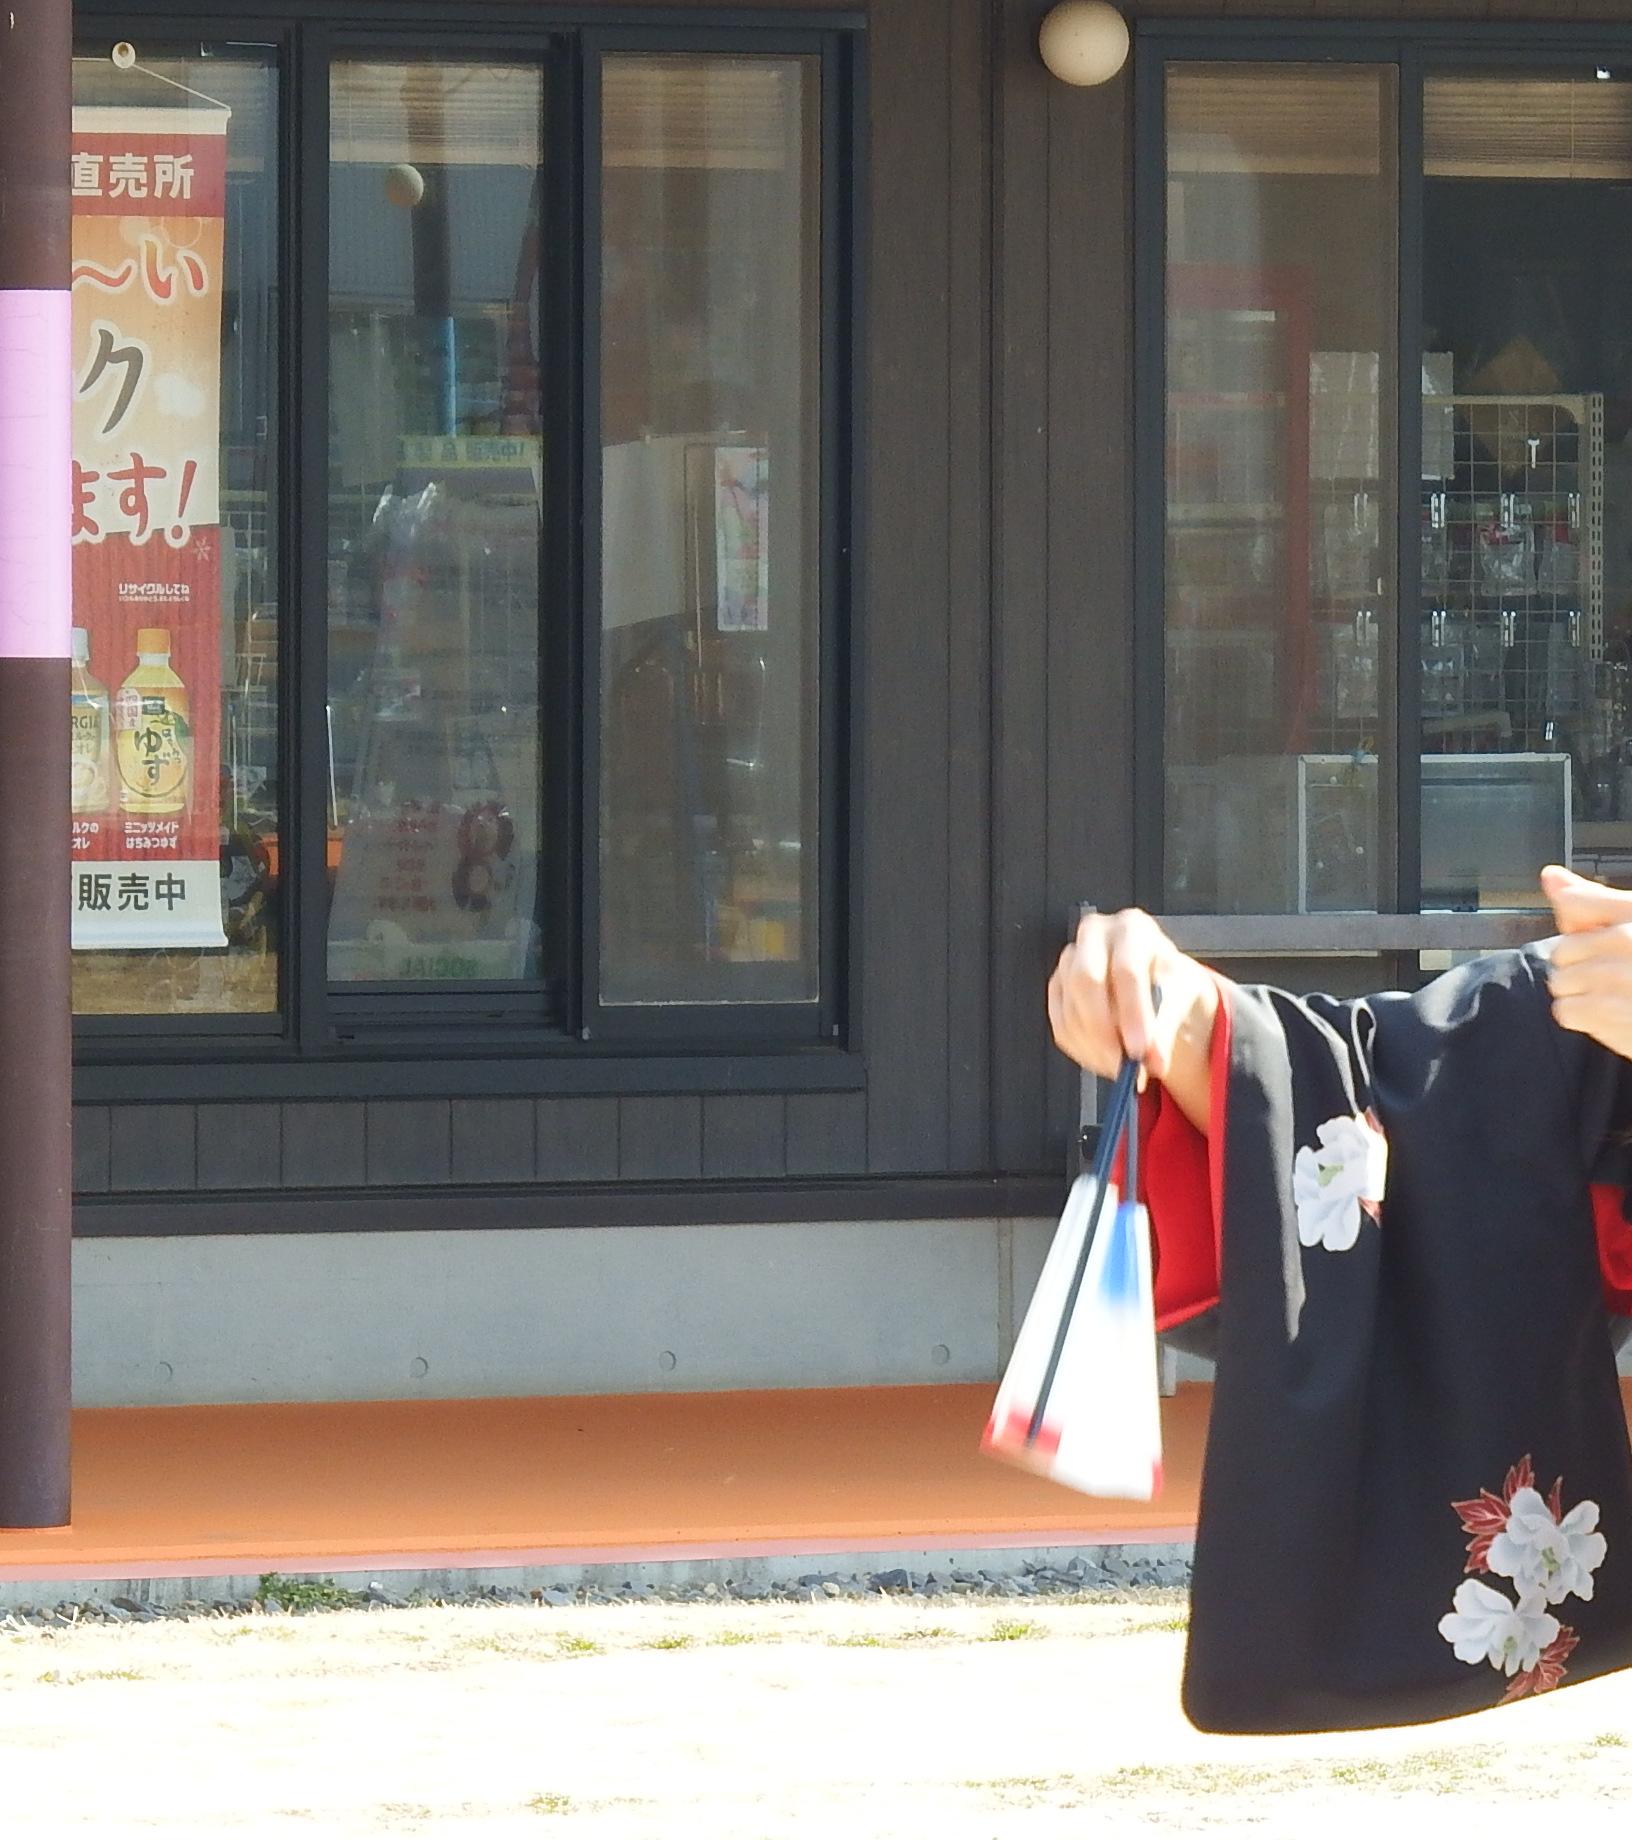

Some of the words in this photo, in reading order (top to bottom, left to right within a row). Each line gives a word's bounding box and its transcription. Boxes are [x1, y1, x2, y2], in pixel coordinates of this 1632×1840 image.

[72, 152, 194, 199] 直売所
[80, 329, 143, 434] ク
[119, 583, 189, 595] リサイクルしてね
[126, 836, 178, 849] はちみつゆず
[78, 872, 186, 911] 販売中
